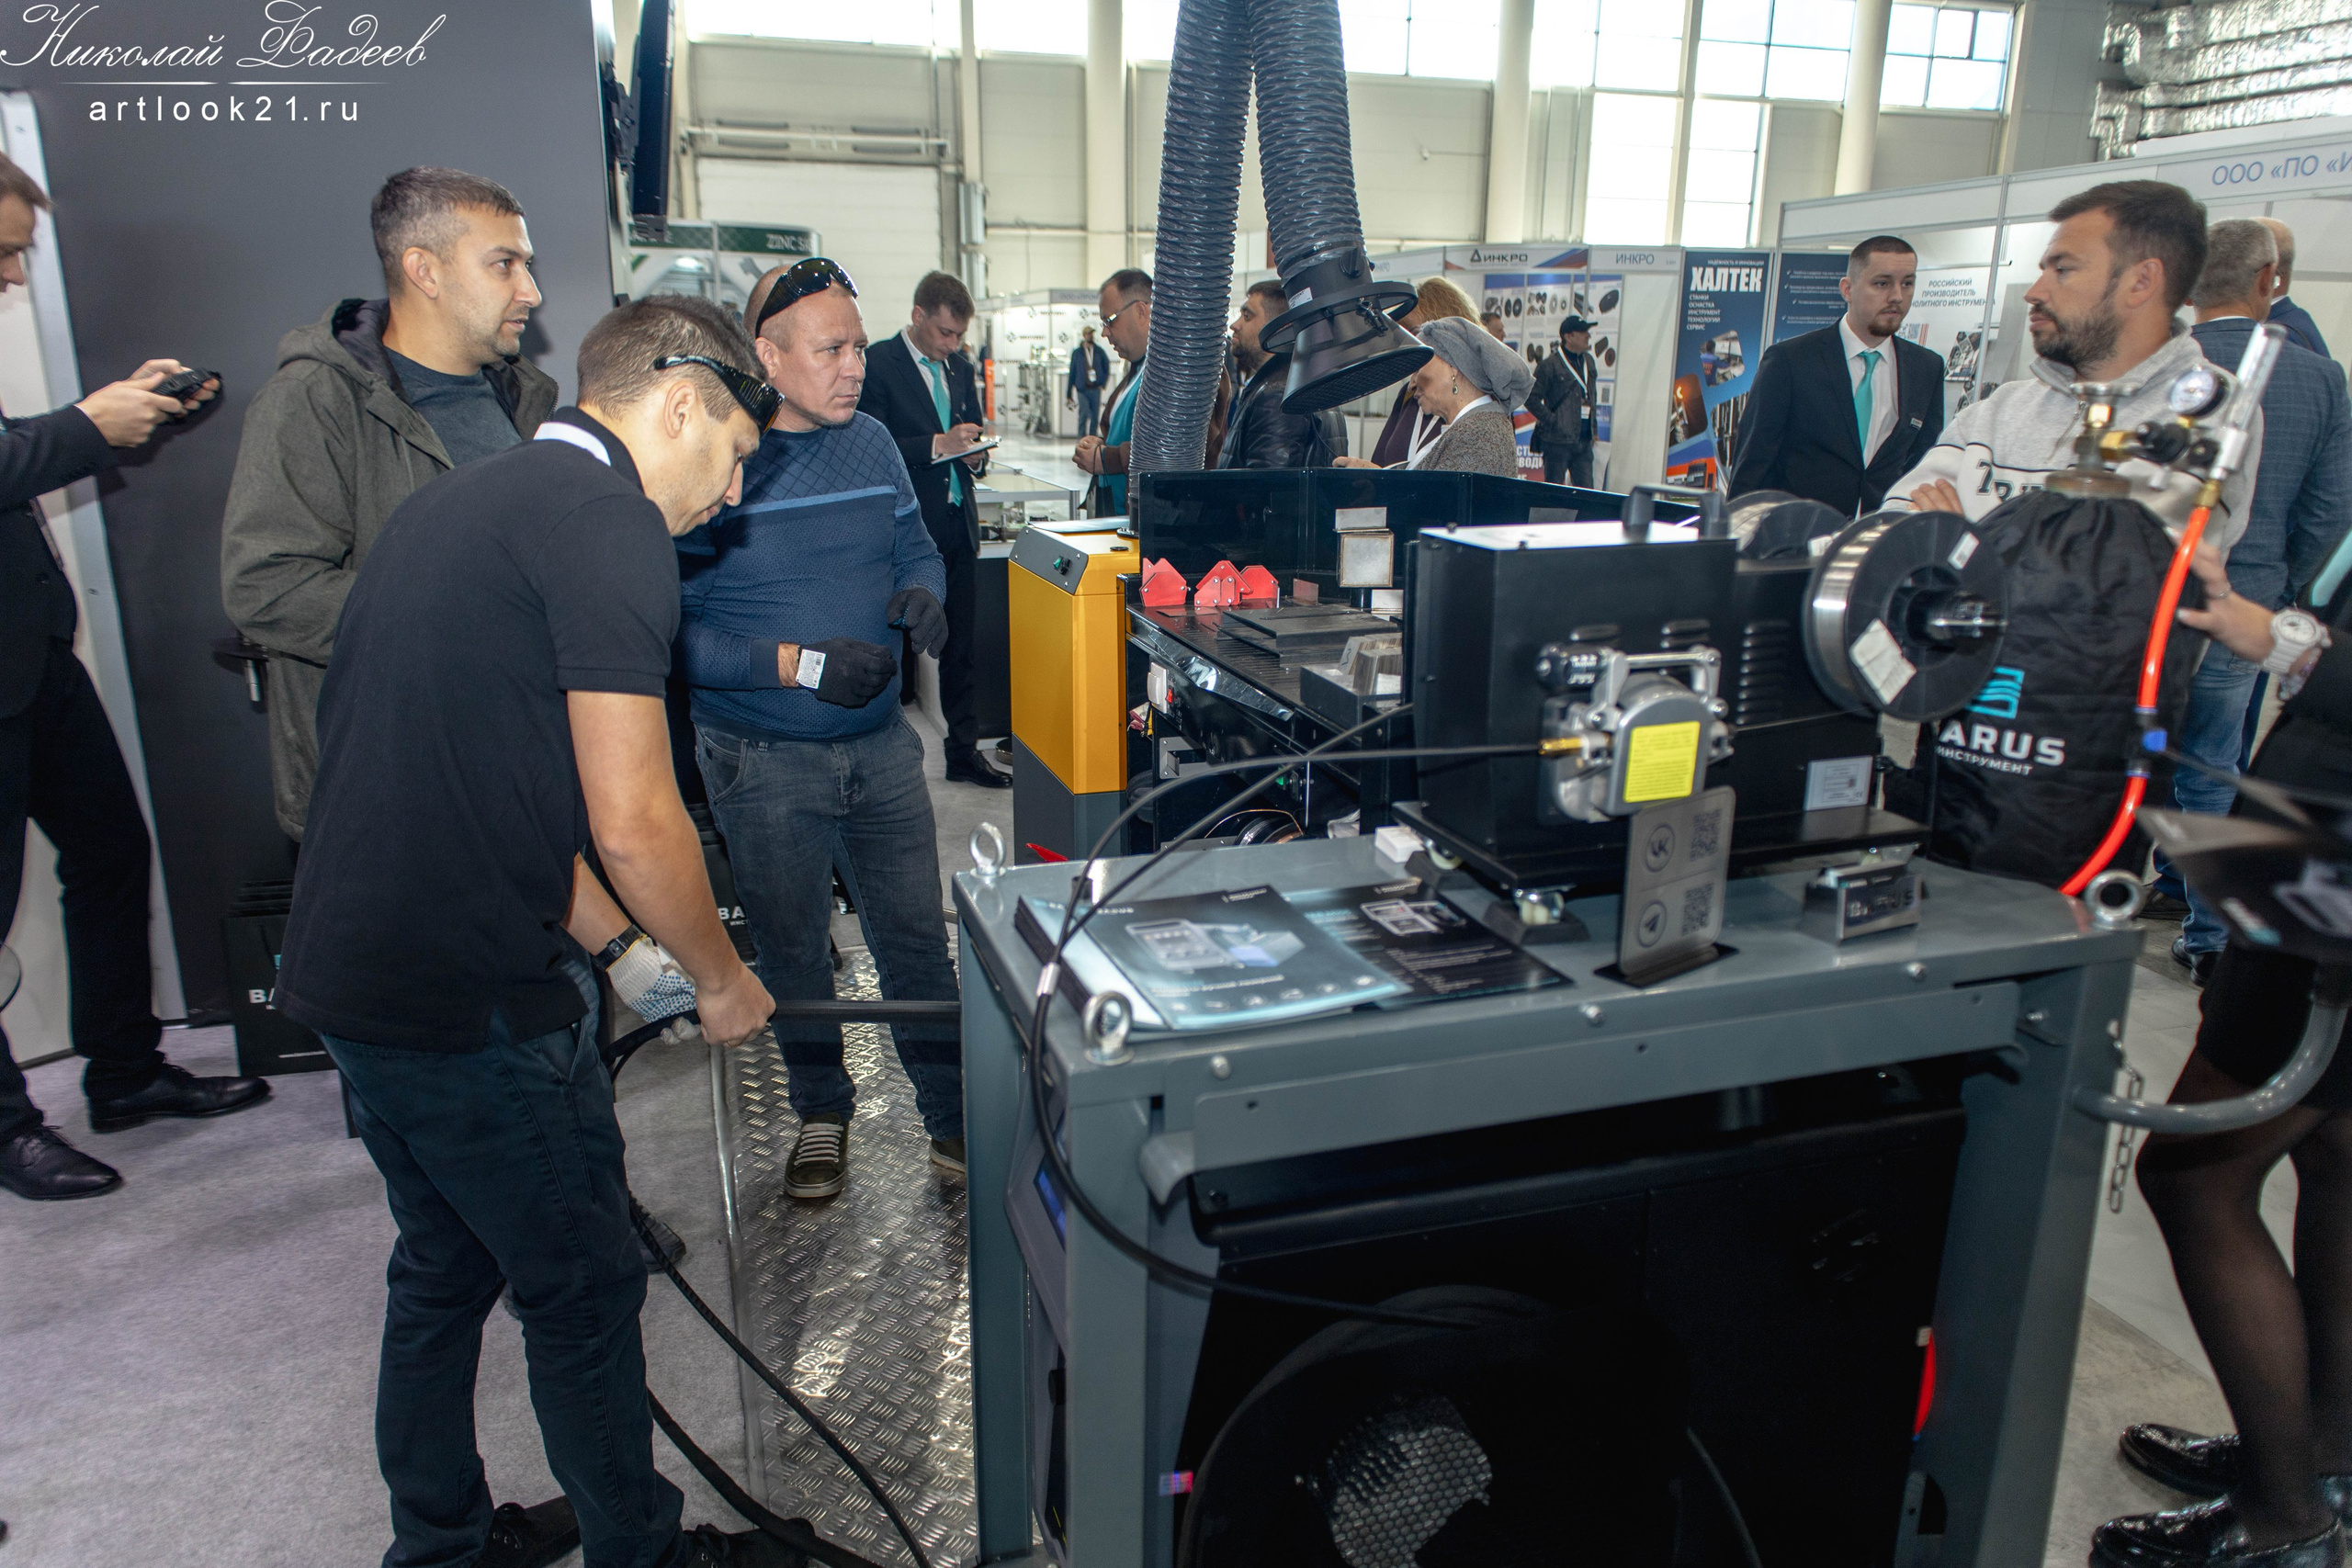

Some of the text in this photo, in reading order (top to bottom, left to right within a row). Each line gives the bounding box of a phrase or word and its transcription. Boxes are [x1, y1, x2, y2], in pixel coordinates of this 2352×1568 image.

[2212, 161, 2264, 186] ООО
[2270, 154, 2320, 178] «ПО
[1616, 253, 1655, 265] ИНКРО
[1690, 266, 1763, 293] ХАЛТЕК
[1928, 277, 1973, 288] РОССИЙСКИЙ
[1921, 289, 1976, 298] ПРОИЗВОДИТЕЛЬ
[1939, 720, 2066, 767] ARUS
